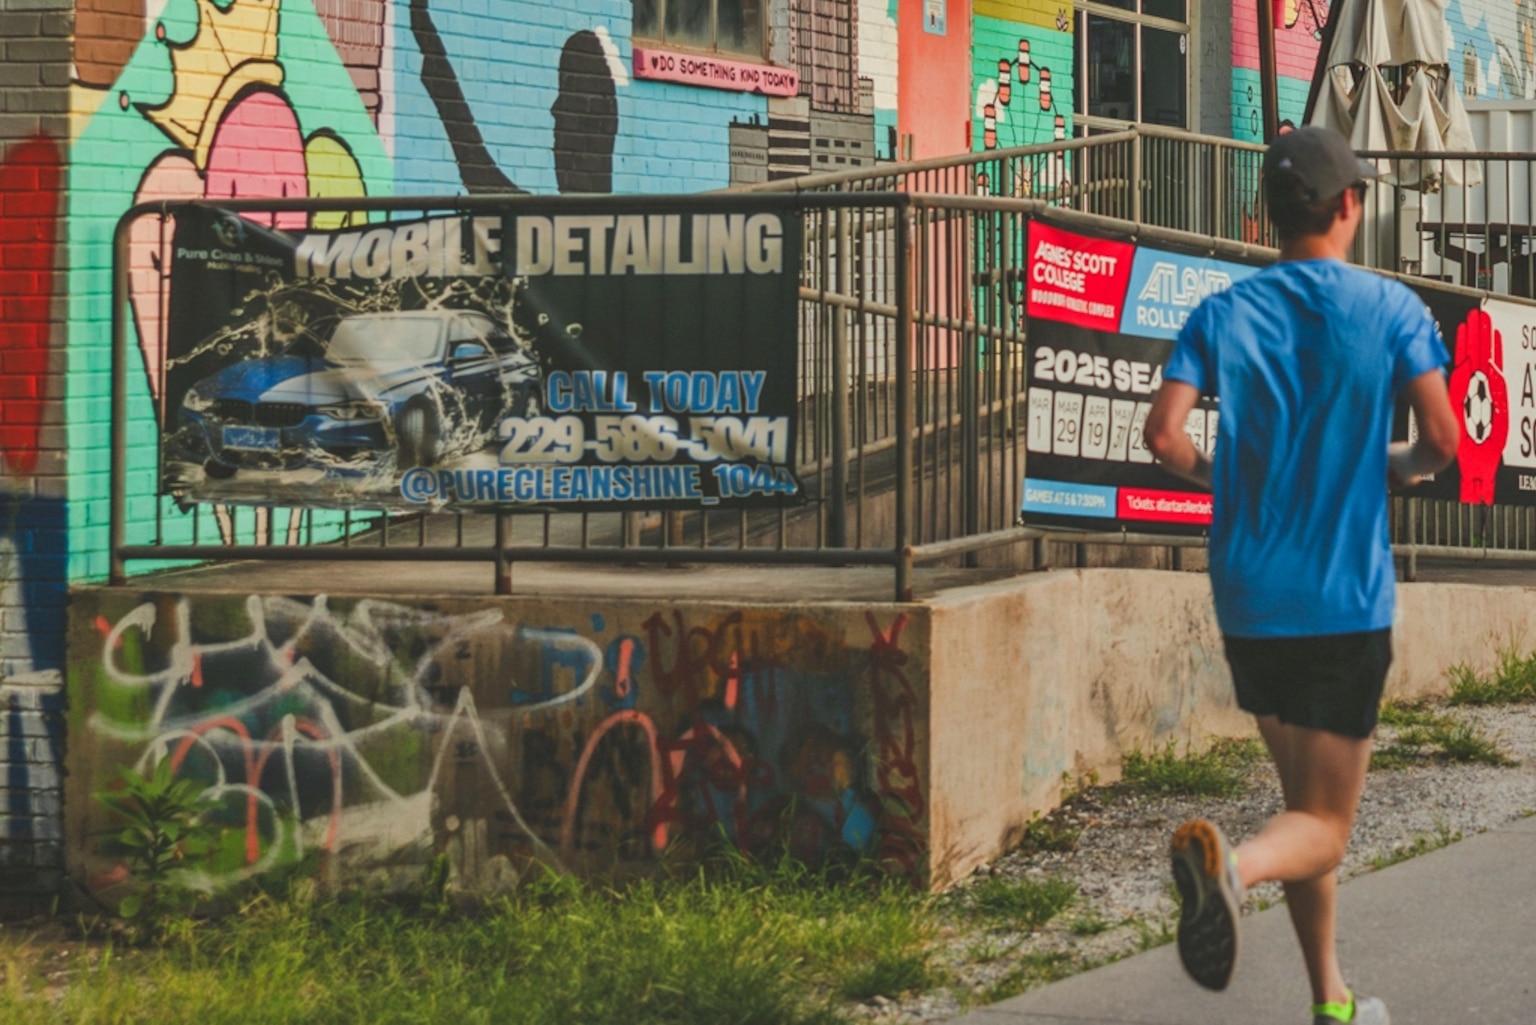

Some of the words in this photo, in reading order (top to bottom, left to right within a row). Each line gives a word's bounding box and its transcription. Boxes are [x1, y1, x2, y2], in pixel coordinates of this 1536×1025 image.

[659, 55, 675, 72] DO
[680, 58, 736, 81] SOMETHING
[740, 69, 760, 83] KIND
[762, 71, 790, 88] TODAY
[177, 247, 208, 260] Pure
[295, 216, 502, 277] MOBILE
[516, 213, 784, 276] DETAILING
[1034, 240, 1073, 269] AGNES
[1073, 251, 1117, 277] SCOTT
[1033, 262, 1086, 293] COLLEGE
[1034, 346, 1112, 389] 2025
[547, 371, 636, 412] CALL
[644, 371, 766, 413] TODAY
[1057, 401, 1079, 416] MAR
[500, 416, 790, 464] 229-586-5041
[1035, 415, 1042, 440] 1
[1056, 418, 1078, 444] 29
[1087, 422, 1104, 447] 19
